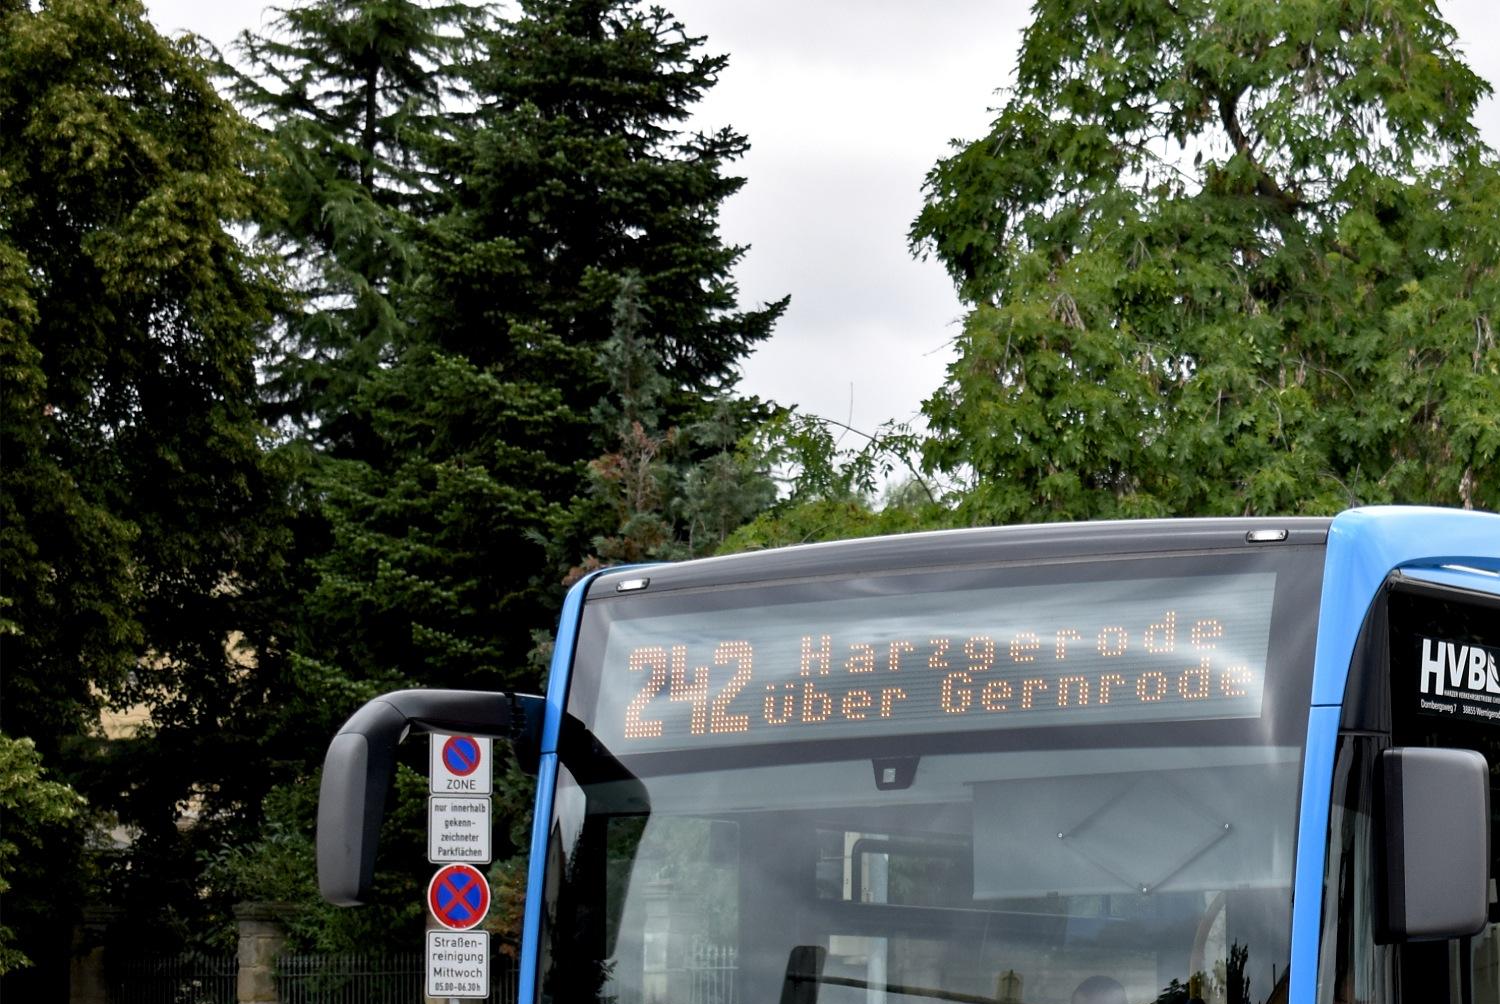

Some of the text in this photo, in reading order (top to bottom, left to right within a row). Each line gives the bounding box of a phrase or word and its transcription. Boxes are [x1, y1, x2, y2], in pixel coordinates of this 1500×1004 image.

[801, 611, 1224, 677] Harzgerode
[1420, 638, 1486, 695] HVB
[624, 640, 753, 739] 242
[763, 657, 1254, 727] über Gernrode
[446, 779, 476, 790] ZONE
[434, 802, 486, 813] nur innerhalb
[444, 817, 476, 829] gekenn-
[440, 832, 480, 842] zeichneter
[437, 846, 483, 857] Parkflächen
[434, 937, 483, 948] Straßen-
[432, 951, 484, 964] reinigung
[433, 967, 483, 978] Mittwoch
